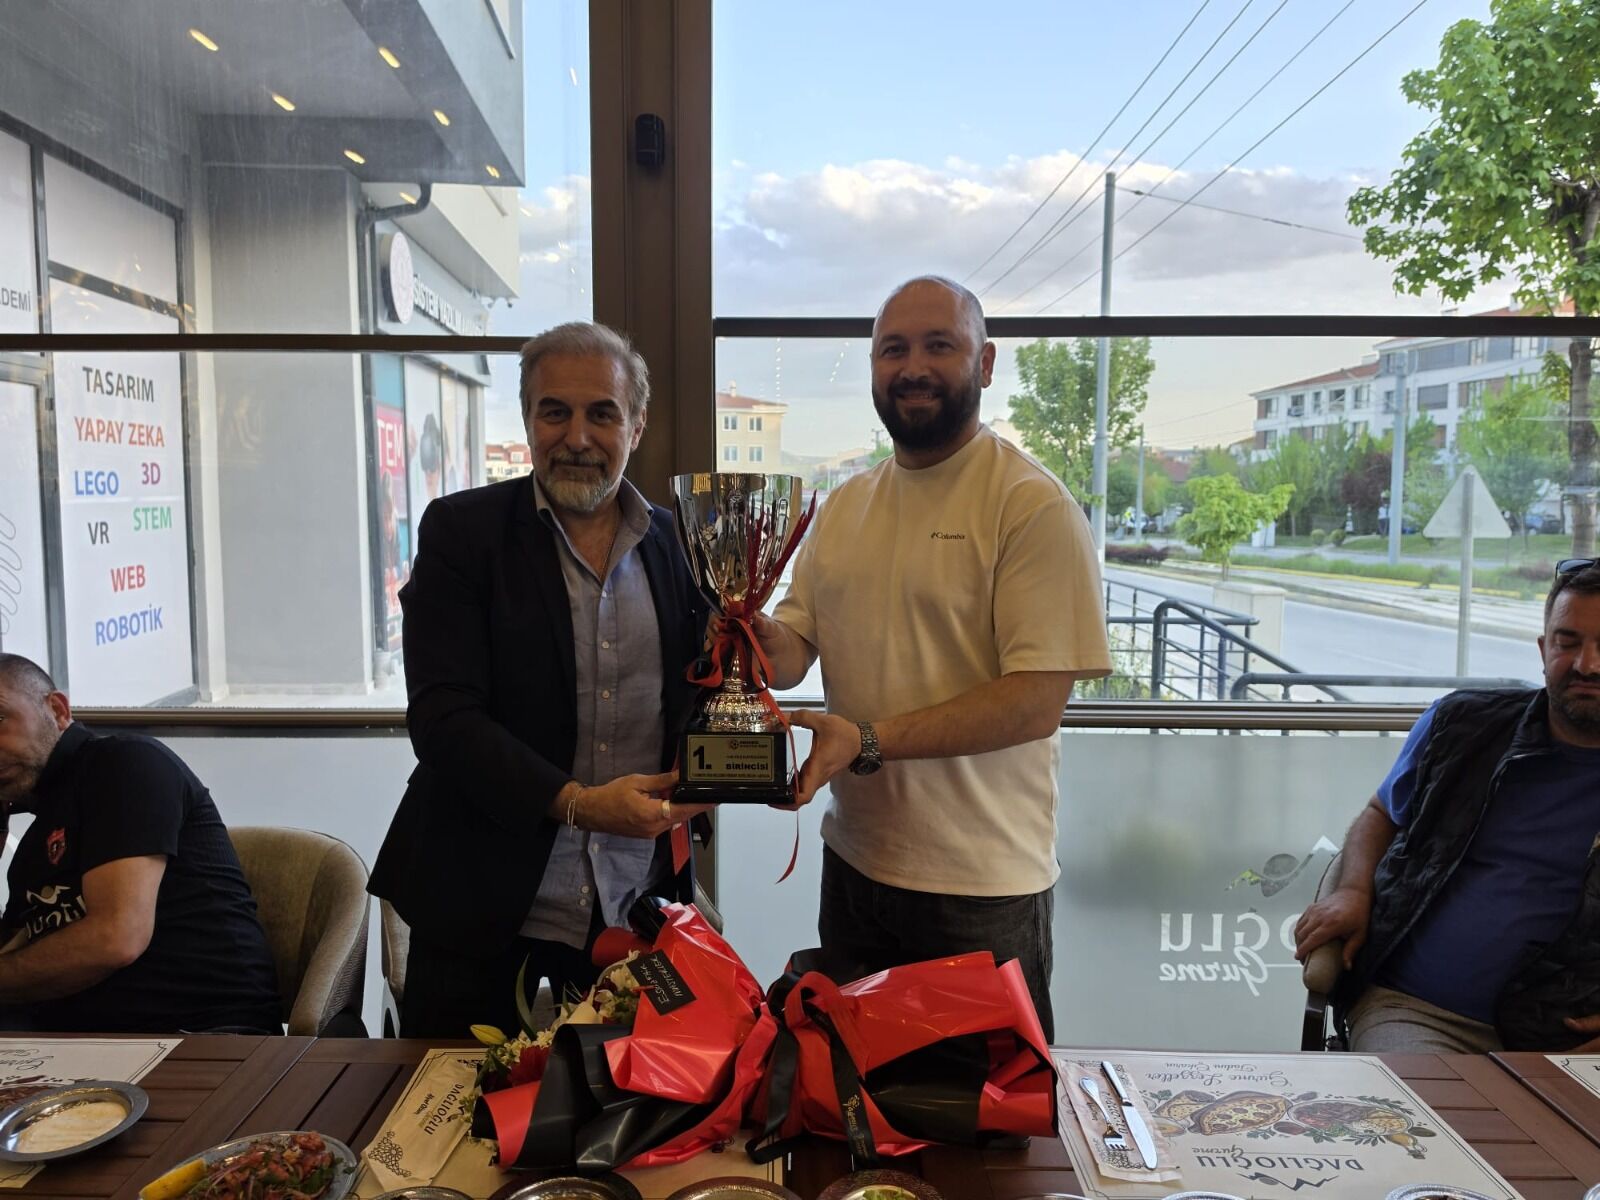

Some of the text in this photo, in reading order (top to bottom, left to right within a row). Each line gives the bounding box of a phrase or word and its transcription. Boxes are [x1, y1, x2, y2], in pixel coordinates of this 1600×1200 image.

[82, 366, 154, 403] TASARIM
[74, 416, 165, 448] YAPAY ZEKA
[74, 470, 119, 496] LEGO
[141, 462, 161, 486] 3D
[133, 507, 172, 532] STEM
[88, 522, 110, 545] VR
[110, 565, 146, 593] WEB
[95, 604, 163, 645] ROBOTİK
[692, 745, 713, 770] 1.
